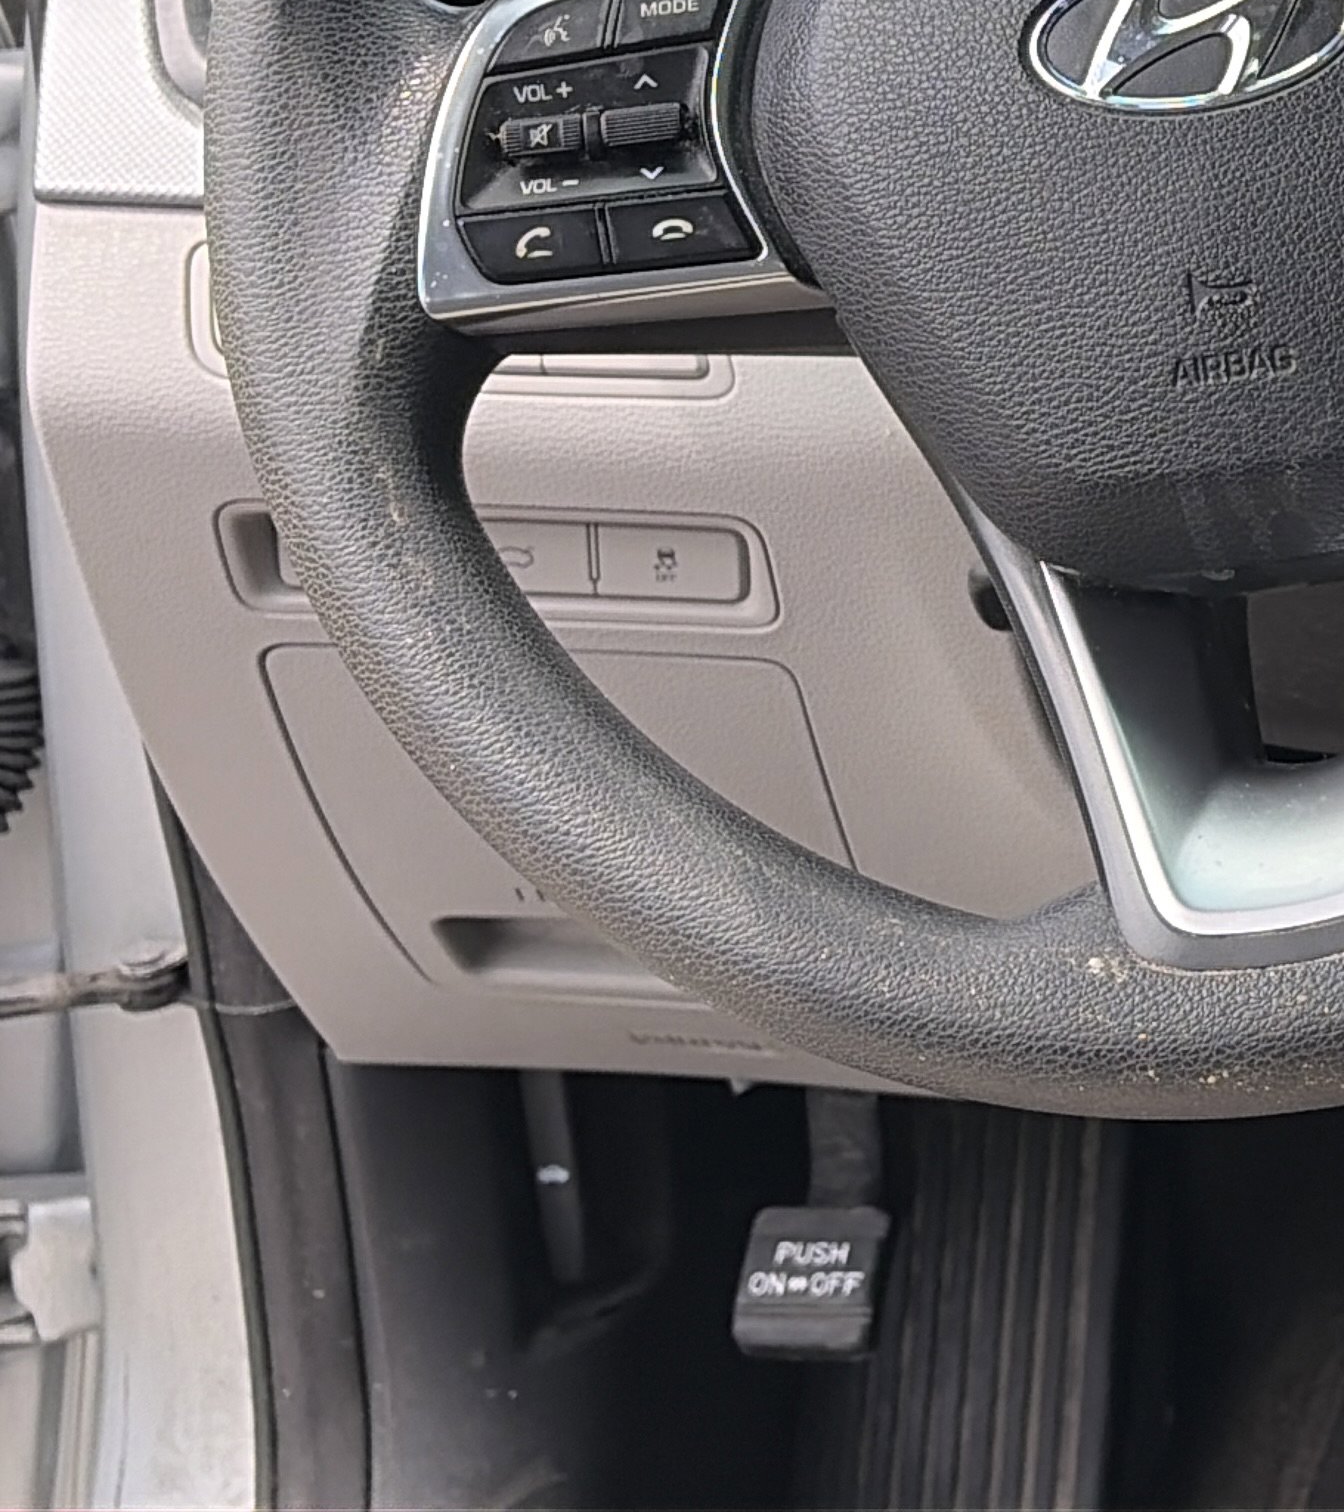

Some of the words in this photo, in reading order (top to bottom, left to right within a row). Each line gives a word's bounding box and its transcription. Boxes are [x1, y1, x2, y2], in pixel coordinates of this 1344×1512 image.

[514, 84, 552, 102] VOL
[520, 177, 557, 194] VOL
[1172, 347, 1297, 387] AIRBAG
[773, 1241, 851, 1266] PUSH
[748, 1273, 785, 1297] ON
[810, 1272, 865, 1297] OFF
